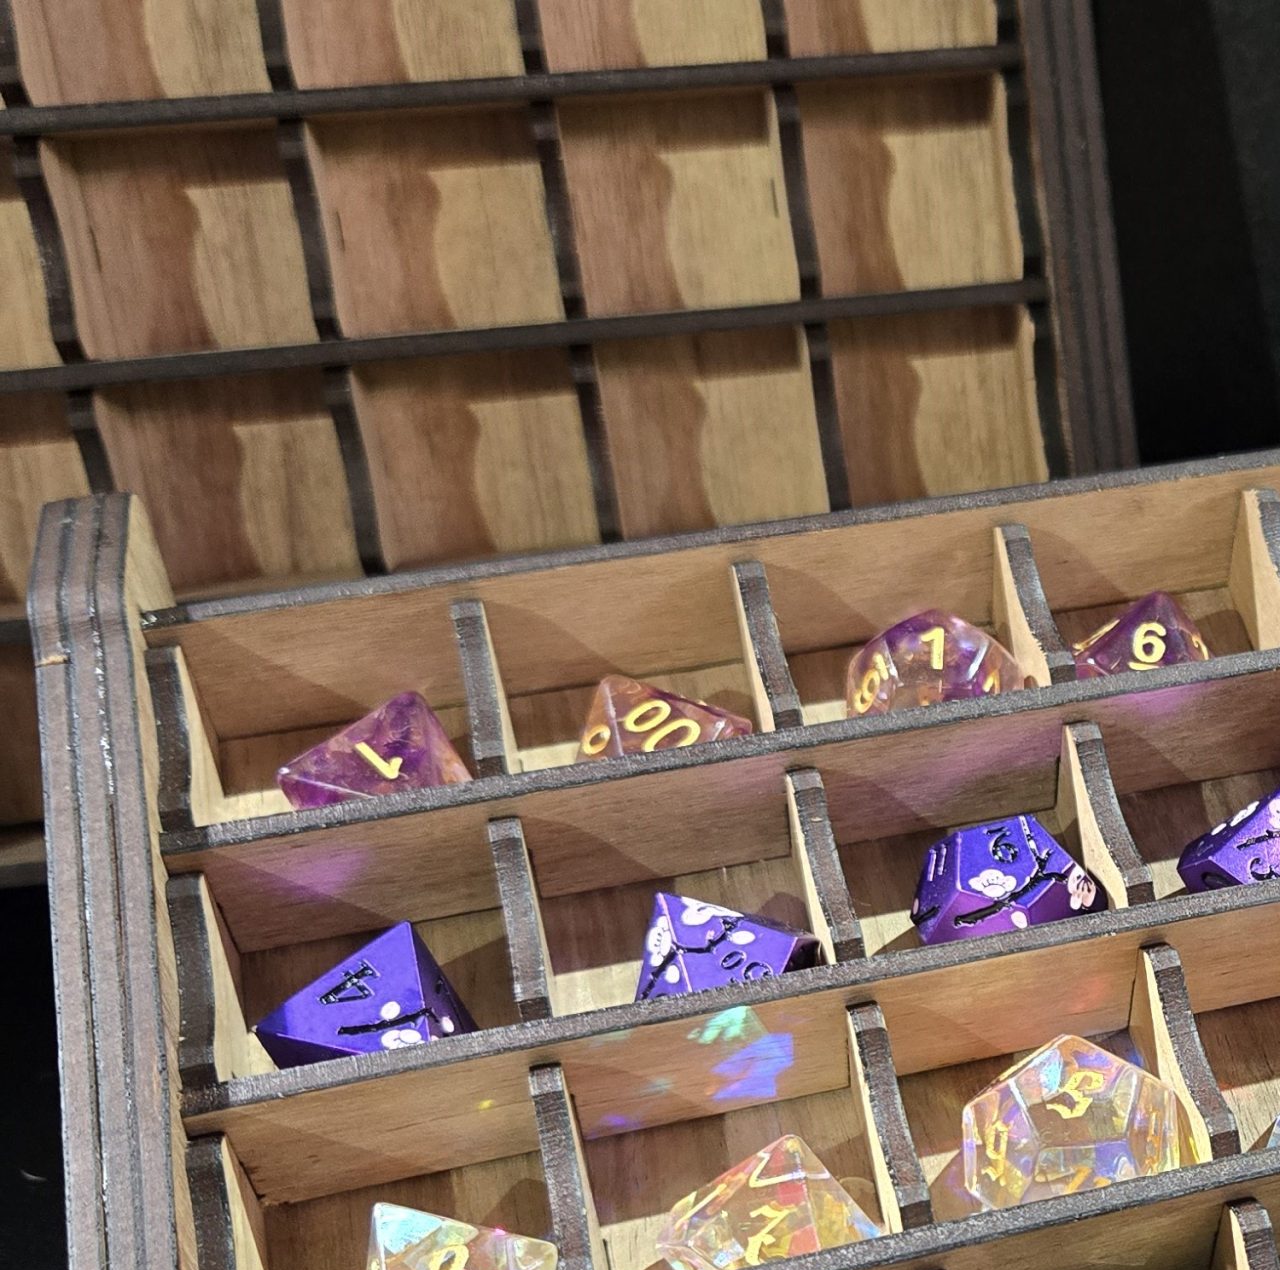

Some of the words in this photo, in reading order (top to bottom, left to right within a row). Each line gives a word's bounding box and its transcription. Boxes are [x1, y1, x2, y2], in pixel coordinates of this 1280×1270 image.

[920, 626, 945, 670] 1
[1133, 621, 1167, 664] 6
[317, 957, 381, 1006] 4
